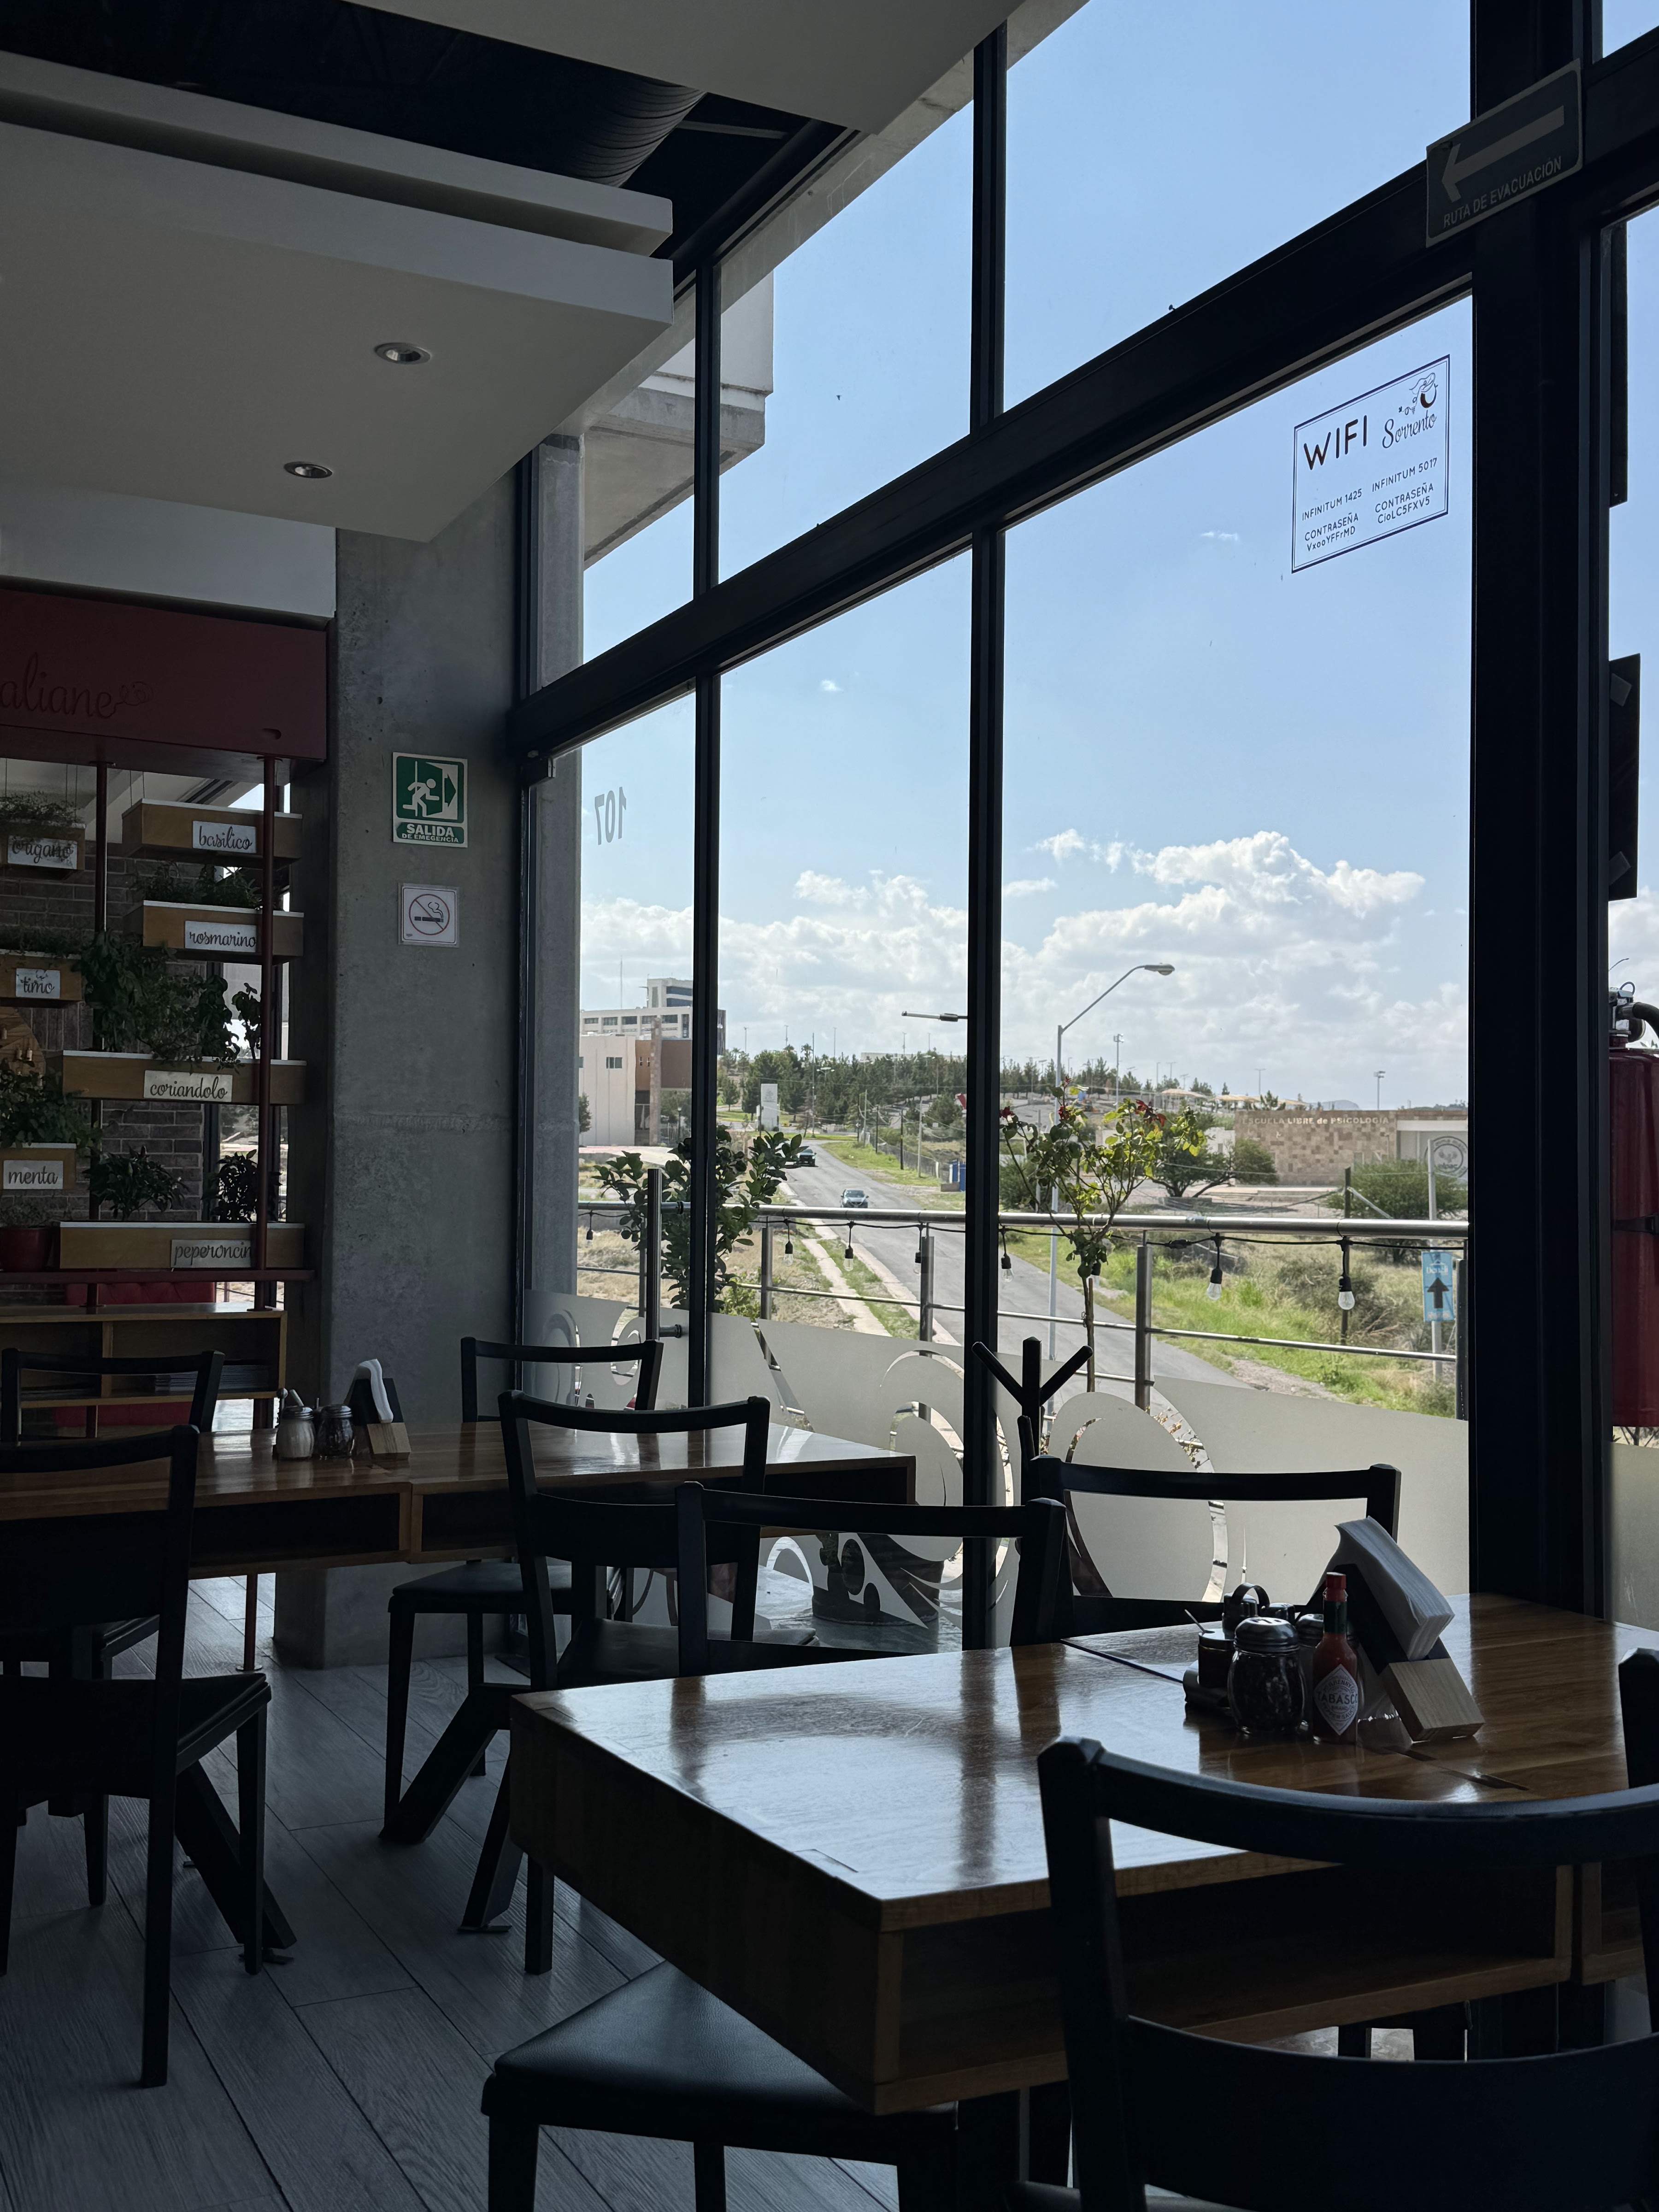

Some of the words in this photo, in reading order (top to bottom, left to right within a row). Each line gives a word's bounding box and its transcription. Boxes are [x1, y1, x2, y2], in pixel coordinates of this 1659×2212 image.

[1443, 203, 1471, 229] RUTA
[1473, 194, 1488, 214] DE
[1490, 155, 1562, 204] EVACUACIÓN
[1304, 415, 1367, 470] WIFI
[1382, 410, 1437, 448] Sorrento
[1372, 466, 1416, 491] INFINITUM
[1418, 458, 1437, 472] 5017
[1302, 498, 1342, 520] INFINITUM
[1345, 488, 1362, 502] 1425
[1375, 483, 1434, 512] CONTRASEÑA
[1305, 512, 1359, 541] CONTRASEÑA
[198, 824, 253, 851] basilico
[406, 823, 454, 838] SALIDA
[189, 930, 257, 948] rosmarino
[23, 976, 55, 994] timo
[149, 1077, 228, 1100] coriandolo
[7, 1165, 59, 1185] menta
[173, 1241, 251, 1266] peperoncin
